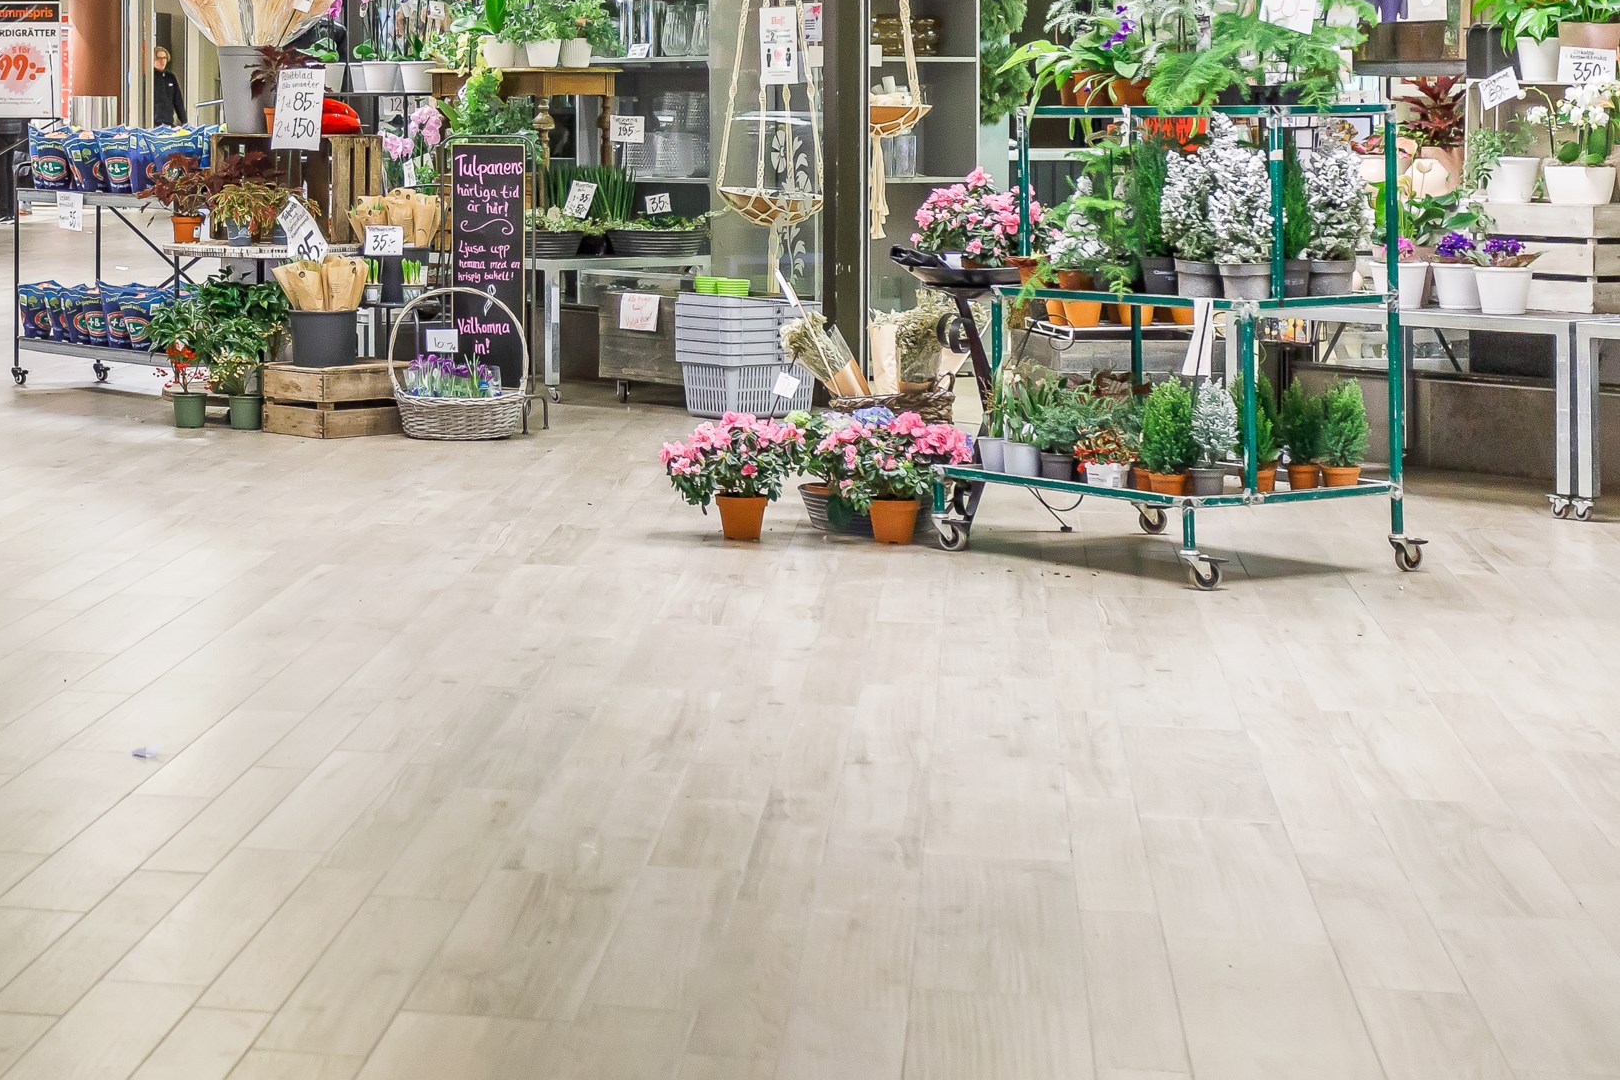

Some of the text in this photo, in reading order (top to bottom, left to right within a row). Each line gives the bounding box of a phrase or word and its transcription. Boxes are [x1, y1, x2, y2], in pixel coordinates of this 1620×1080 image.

[454, 153, 524, 185] Tulpanens
[456, 184, 520, 202] härliga tid
[467, 200, 509, 217] är här!
[458, 240, 511, 259] Ljusa upp
[458, 260, 521, 269] hemma med en
[457, 271, 481, 283] krispig
[457, 316, 511, 335] Välkomna
[474, 338, 491, 354] in!
